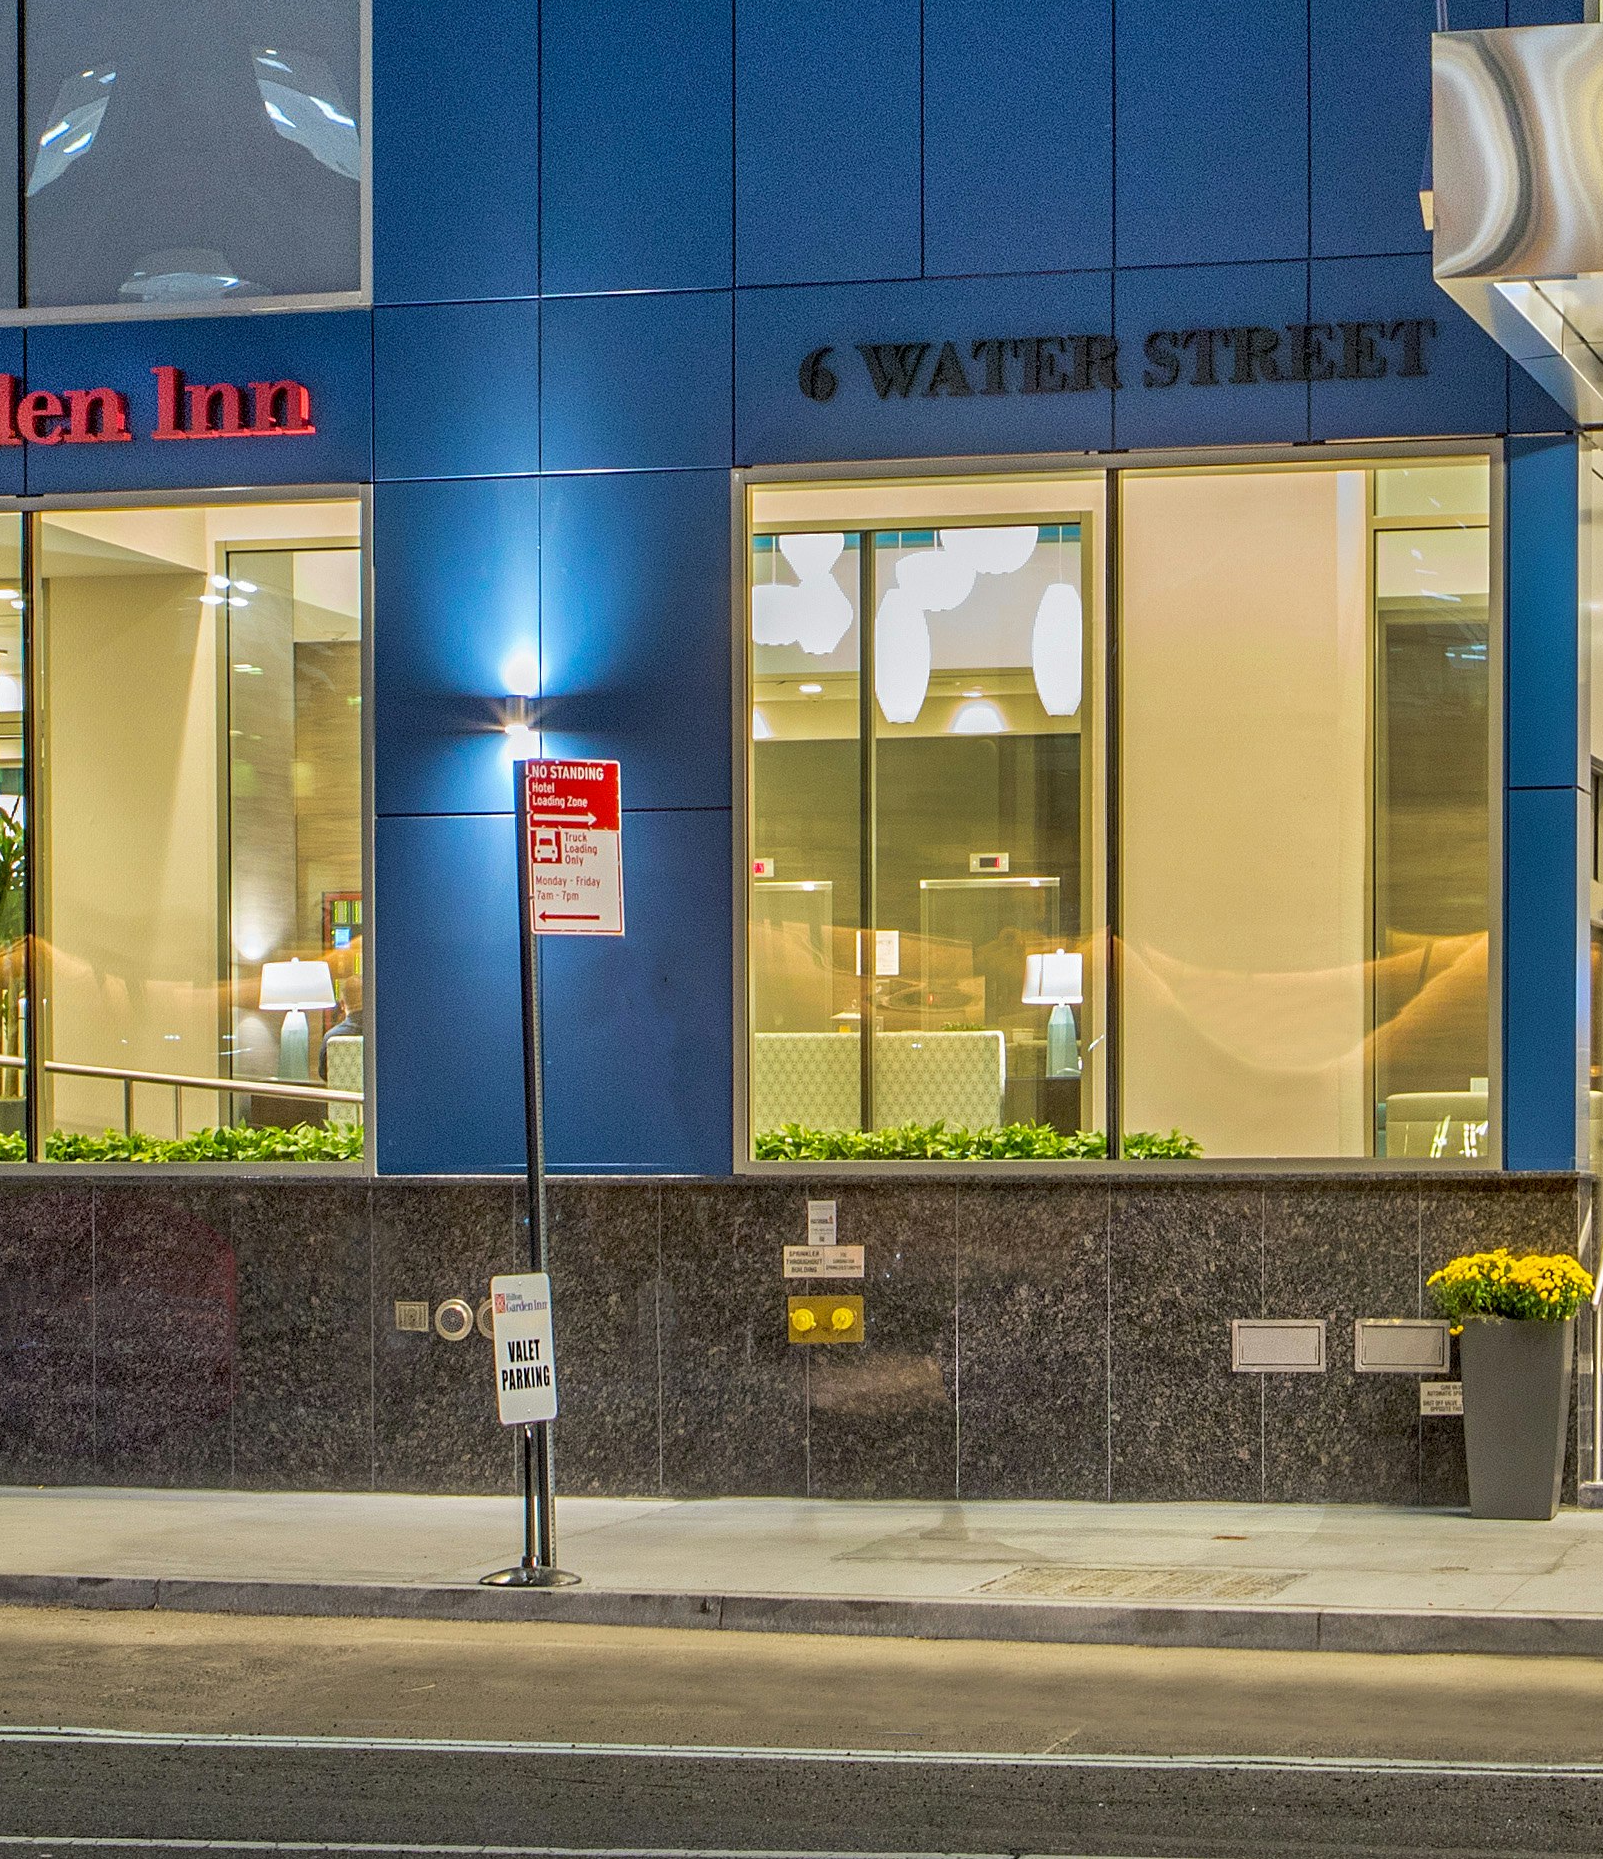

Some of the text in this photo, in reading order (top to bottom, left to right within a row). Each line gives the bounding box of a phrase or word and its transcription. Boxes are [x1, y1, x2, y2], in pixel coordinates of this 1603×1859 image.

[798, 318, 1439, 403] 6 WATER STREET
[151, 365, 316, 441] Inn
[531, 764, 605, 781] NO STANDING
[532, 782, 555, 794] Hotel
[532, 795, 589, 809] Loading Zone
[564, 832, 588, 842] Truck
[564, 843, 598, 855] Loading
[564, 855, 584, 866] Only
[535, 875, 568, 887] Monday
[576, 876, 601, 888] Friday
[537, 890, 554, 900] 7am
[561, 891, 579, 903] 7pm
[506, 1300, 547, 1312] Garden Inn
[507, 1339, 541, 1363] VALET
[501, 1365, 551, 1391] PARKING
